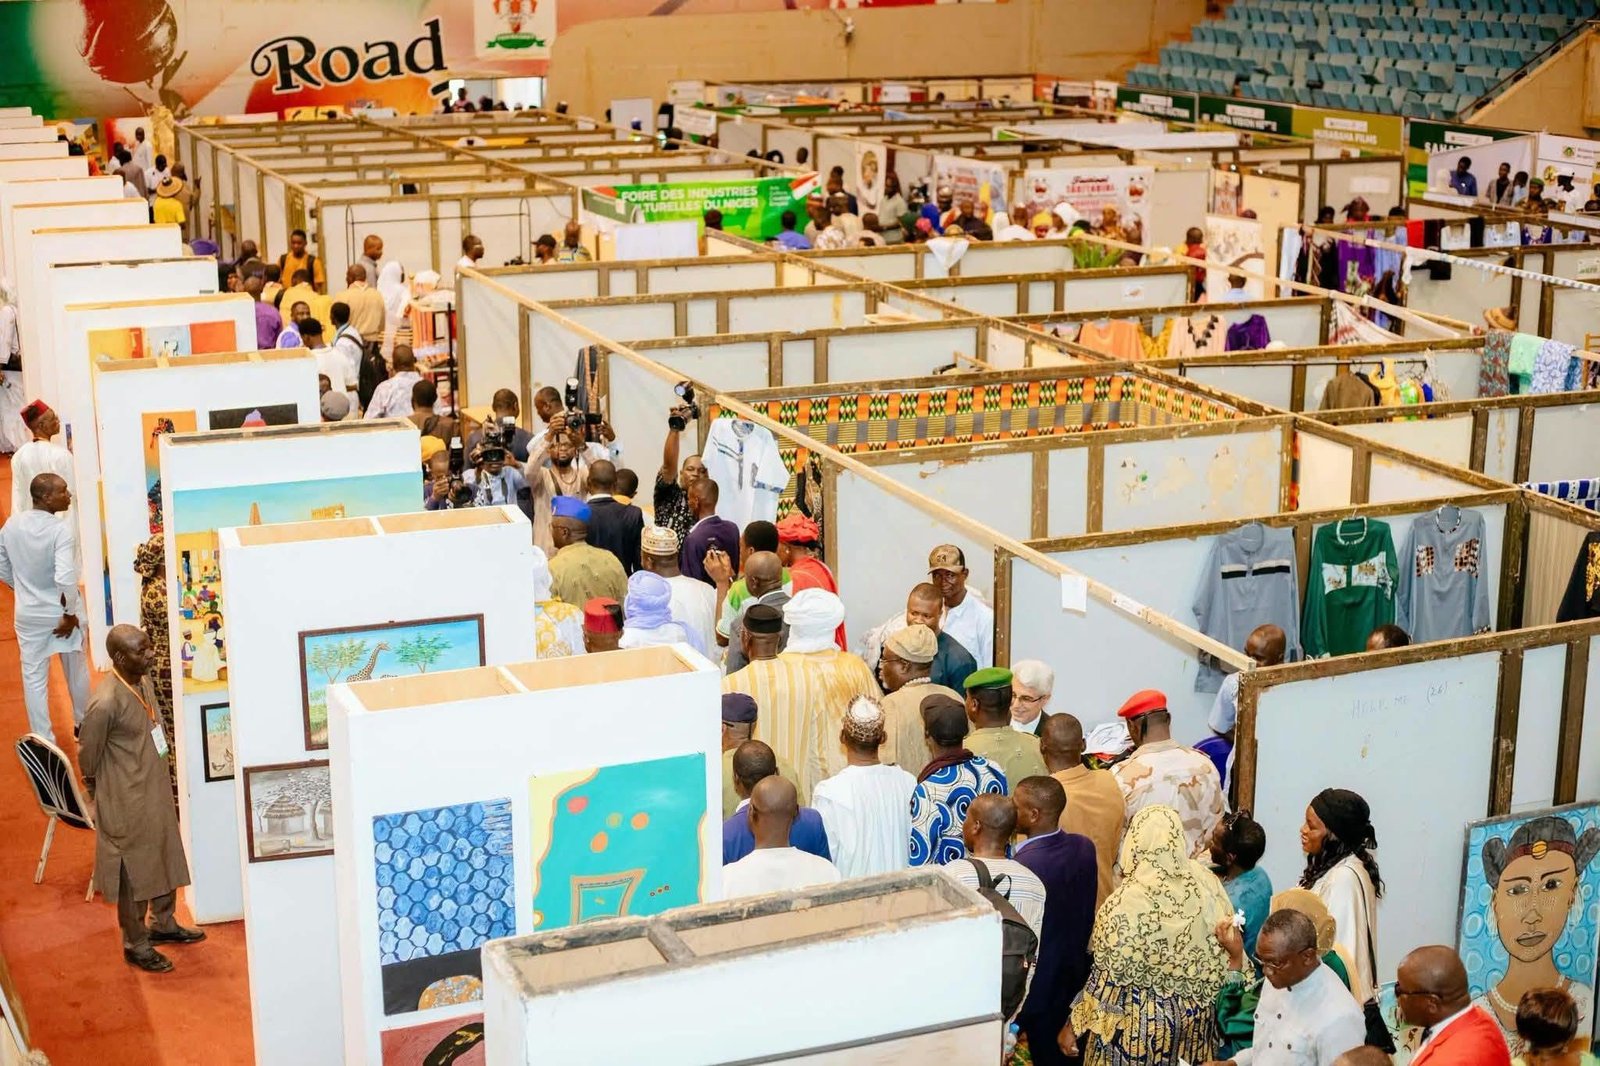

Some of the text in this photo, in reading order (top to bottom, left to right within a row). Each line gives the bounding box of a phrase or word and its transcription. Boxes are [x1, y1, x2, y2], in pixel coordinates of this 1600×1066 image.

[251, 18, 448, 91] Road
[1355, 133, 1377, 145] FILMS
[621, 190, 657, 202] FOIRE
[660, 189, 685, 200] DES
[687, 186, 758, 199] INDUSTRIES
[703, 199, 723, 210] DU
[723, 197, 758, 208] NIGER
